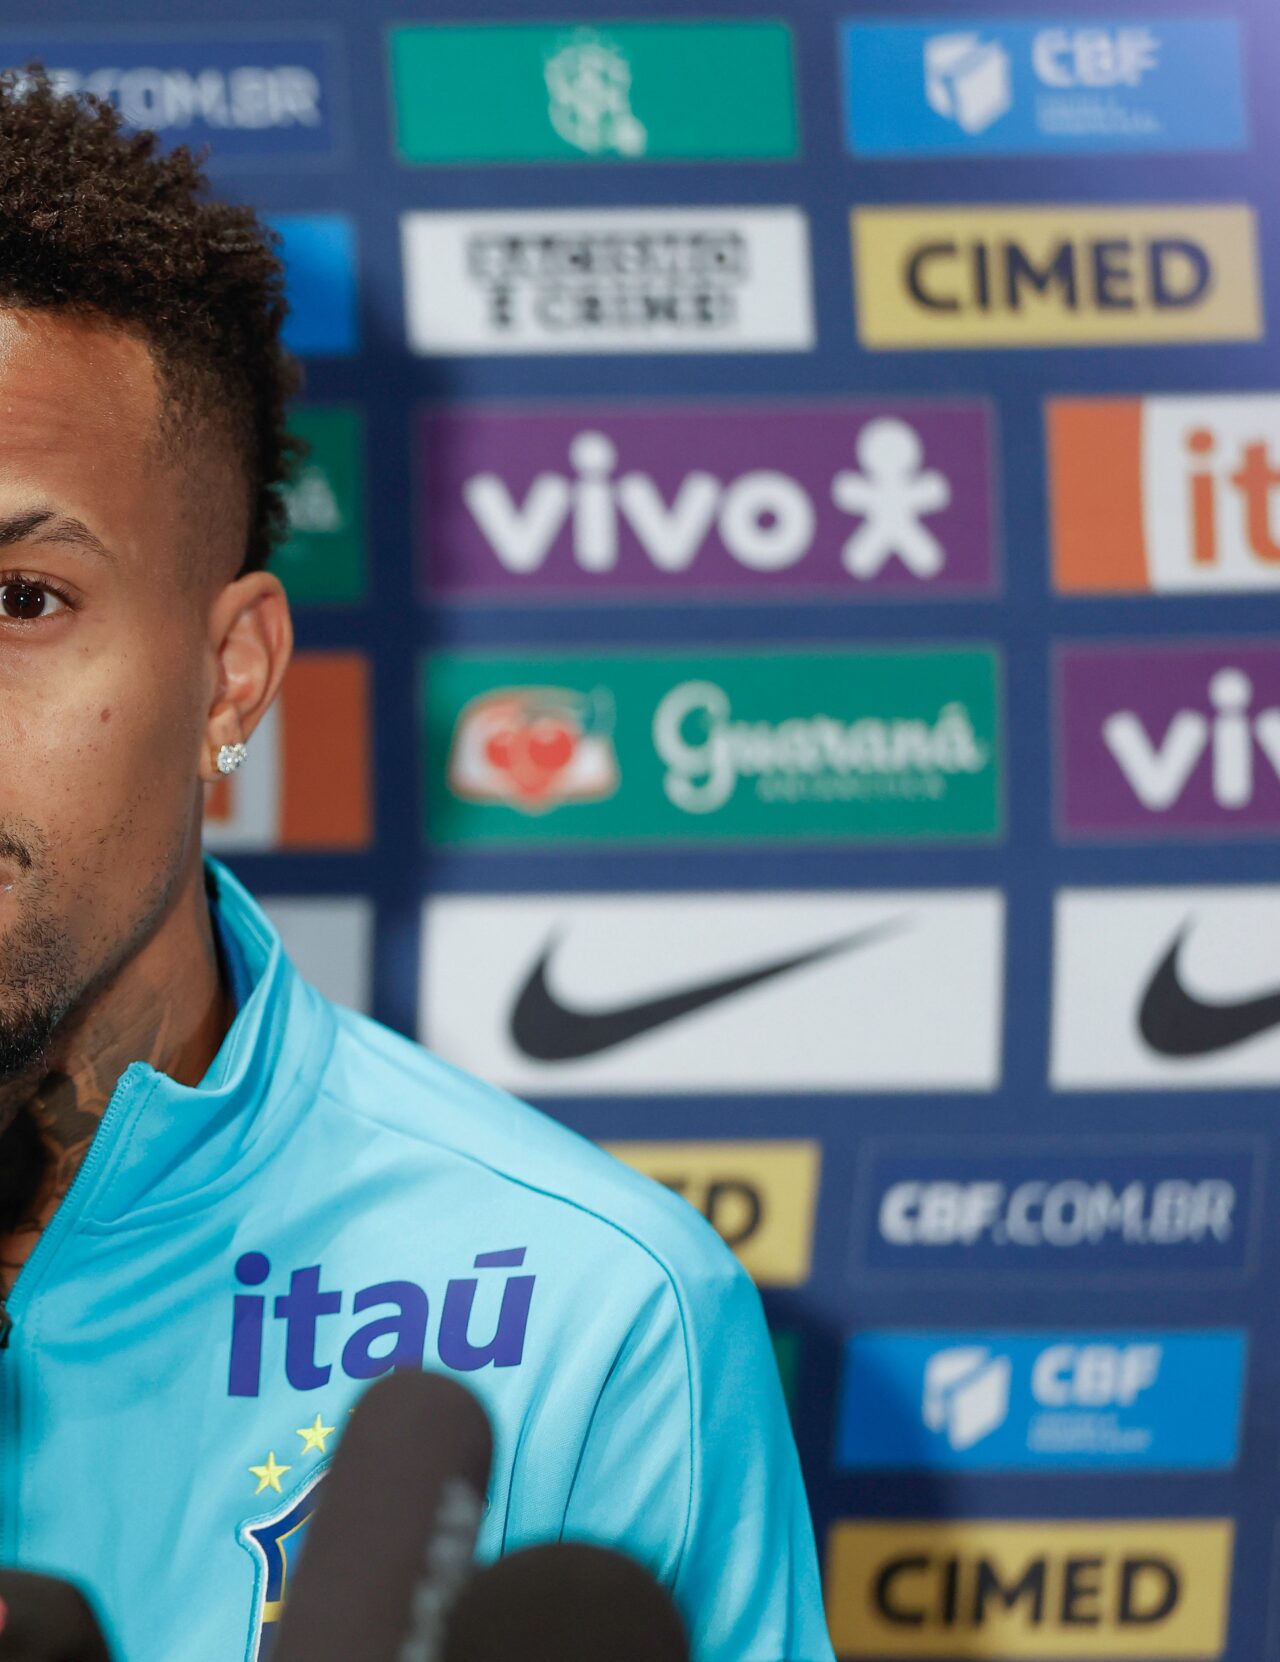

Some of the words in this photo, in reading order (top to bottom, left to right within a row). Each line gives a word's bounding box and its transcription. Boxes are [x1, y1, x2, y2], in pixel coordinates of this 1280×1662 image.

[1032, 27, 1161, 89] CBF
[901, 237, 1213, 316] CIMED
[467, 431, 814, 573] vivo
[879, 1181, 1234, 1245] CBF.COM.BR
[228, 1247, 537, 1398] itaú
[1032, 1345, 1161, 1407] CBF
[873, 1550, 1184, 1629] CIMED
